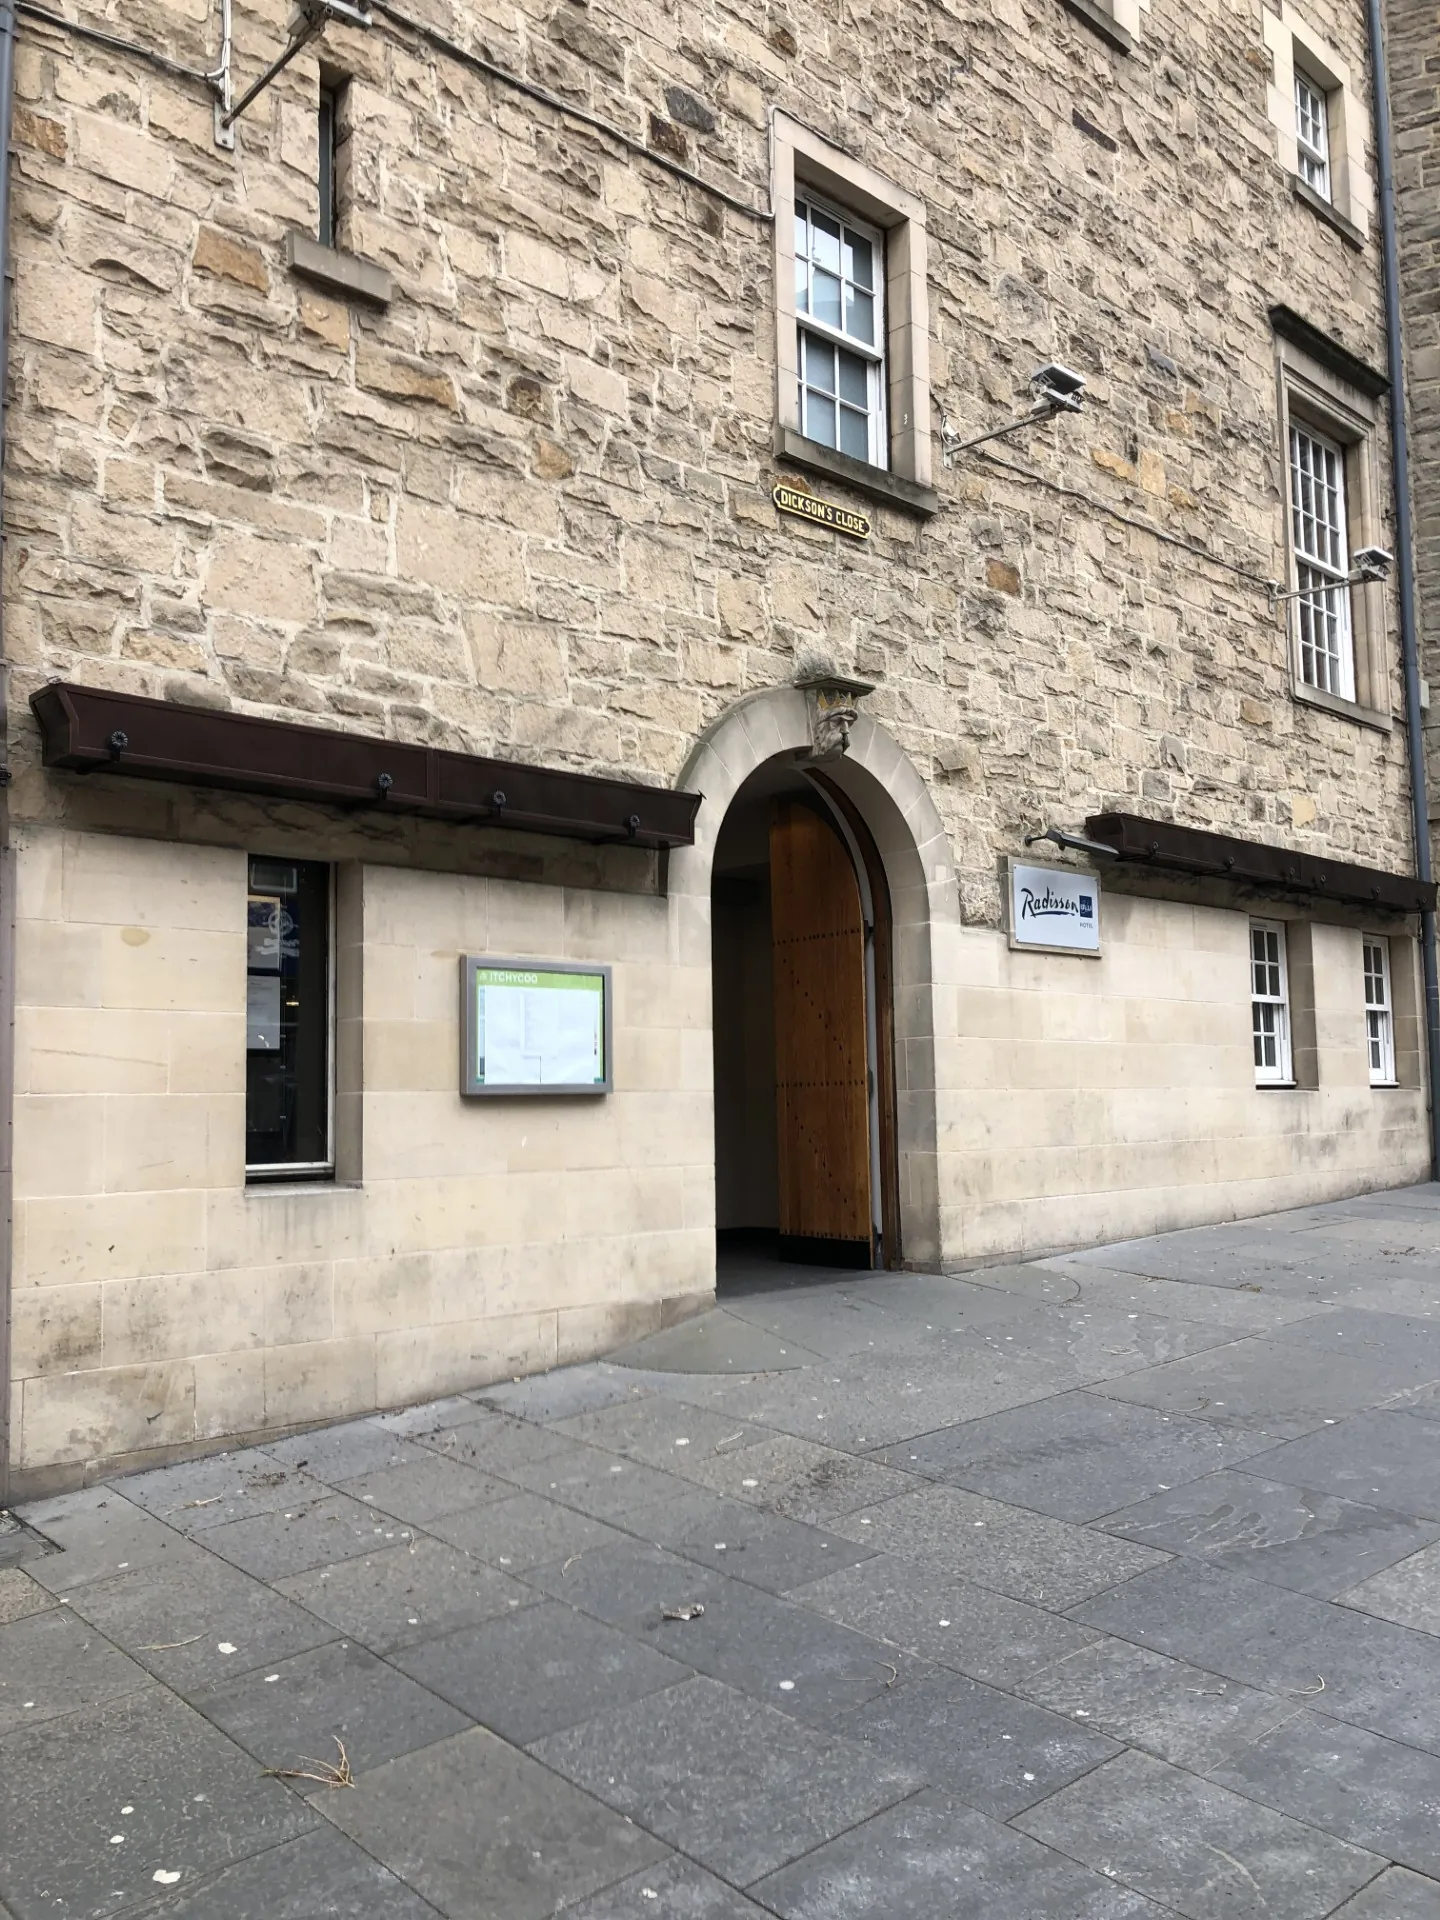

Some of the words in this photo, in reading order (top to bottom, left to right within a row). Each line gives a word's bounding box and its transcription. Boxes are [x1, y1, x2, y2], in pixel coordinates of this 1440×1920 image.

[780, 491, 832, 521] DICKSON'S
[836, 511, 865, 533] CLOSE
[1021, 886, 1079, 920] Radisson
[490, 971, 537, 984] ITCHYCOO
